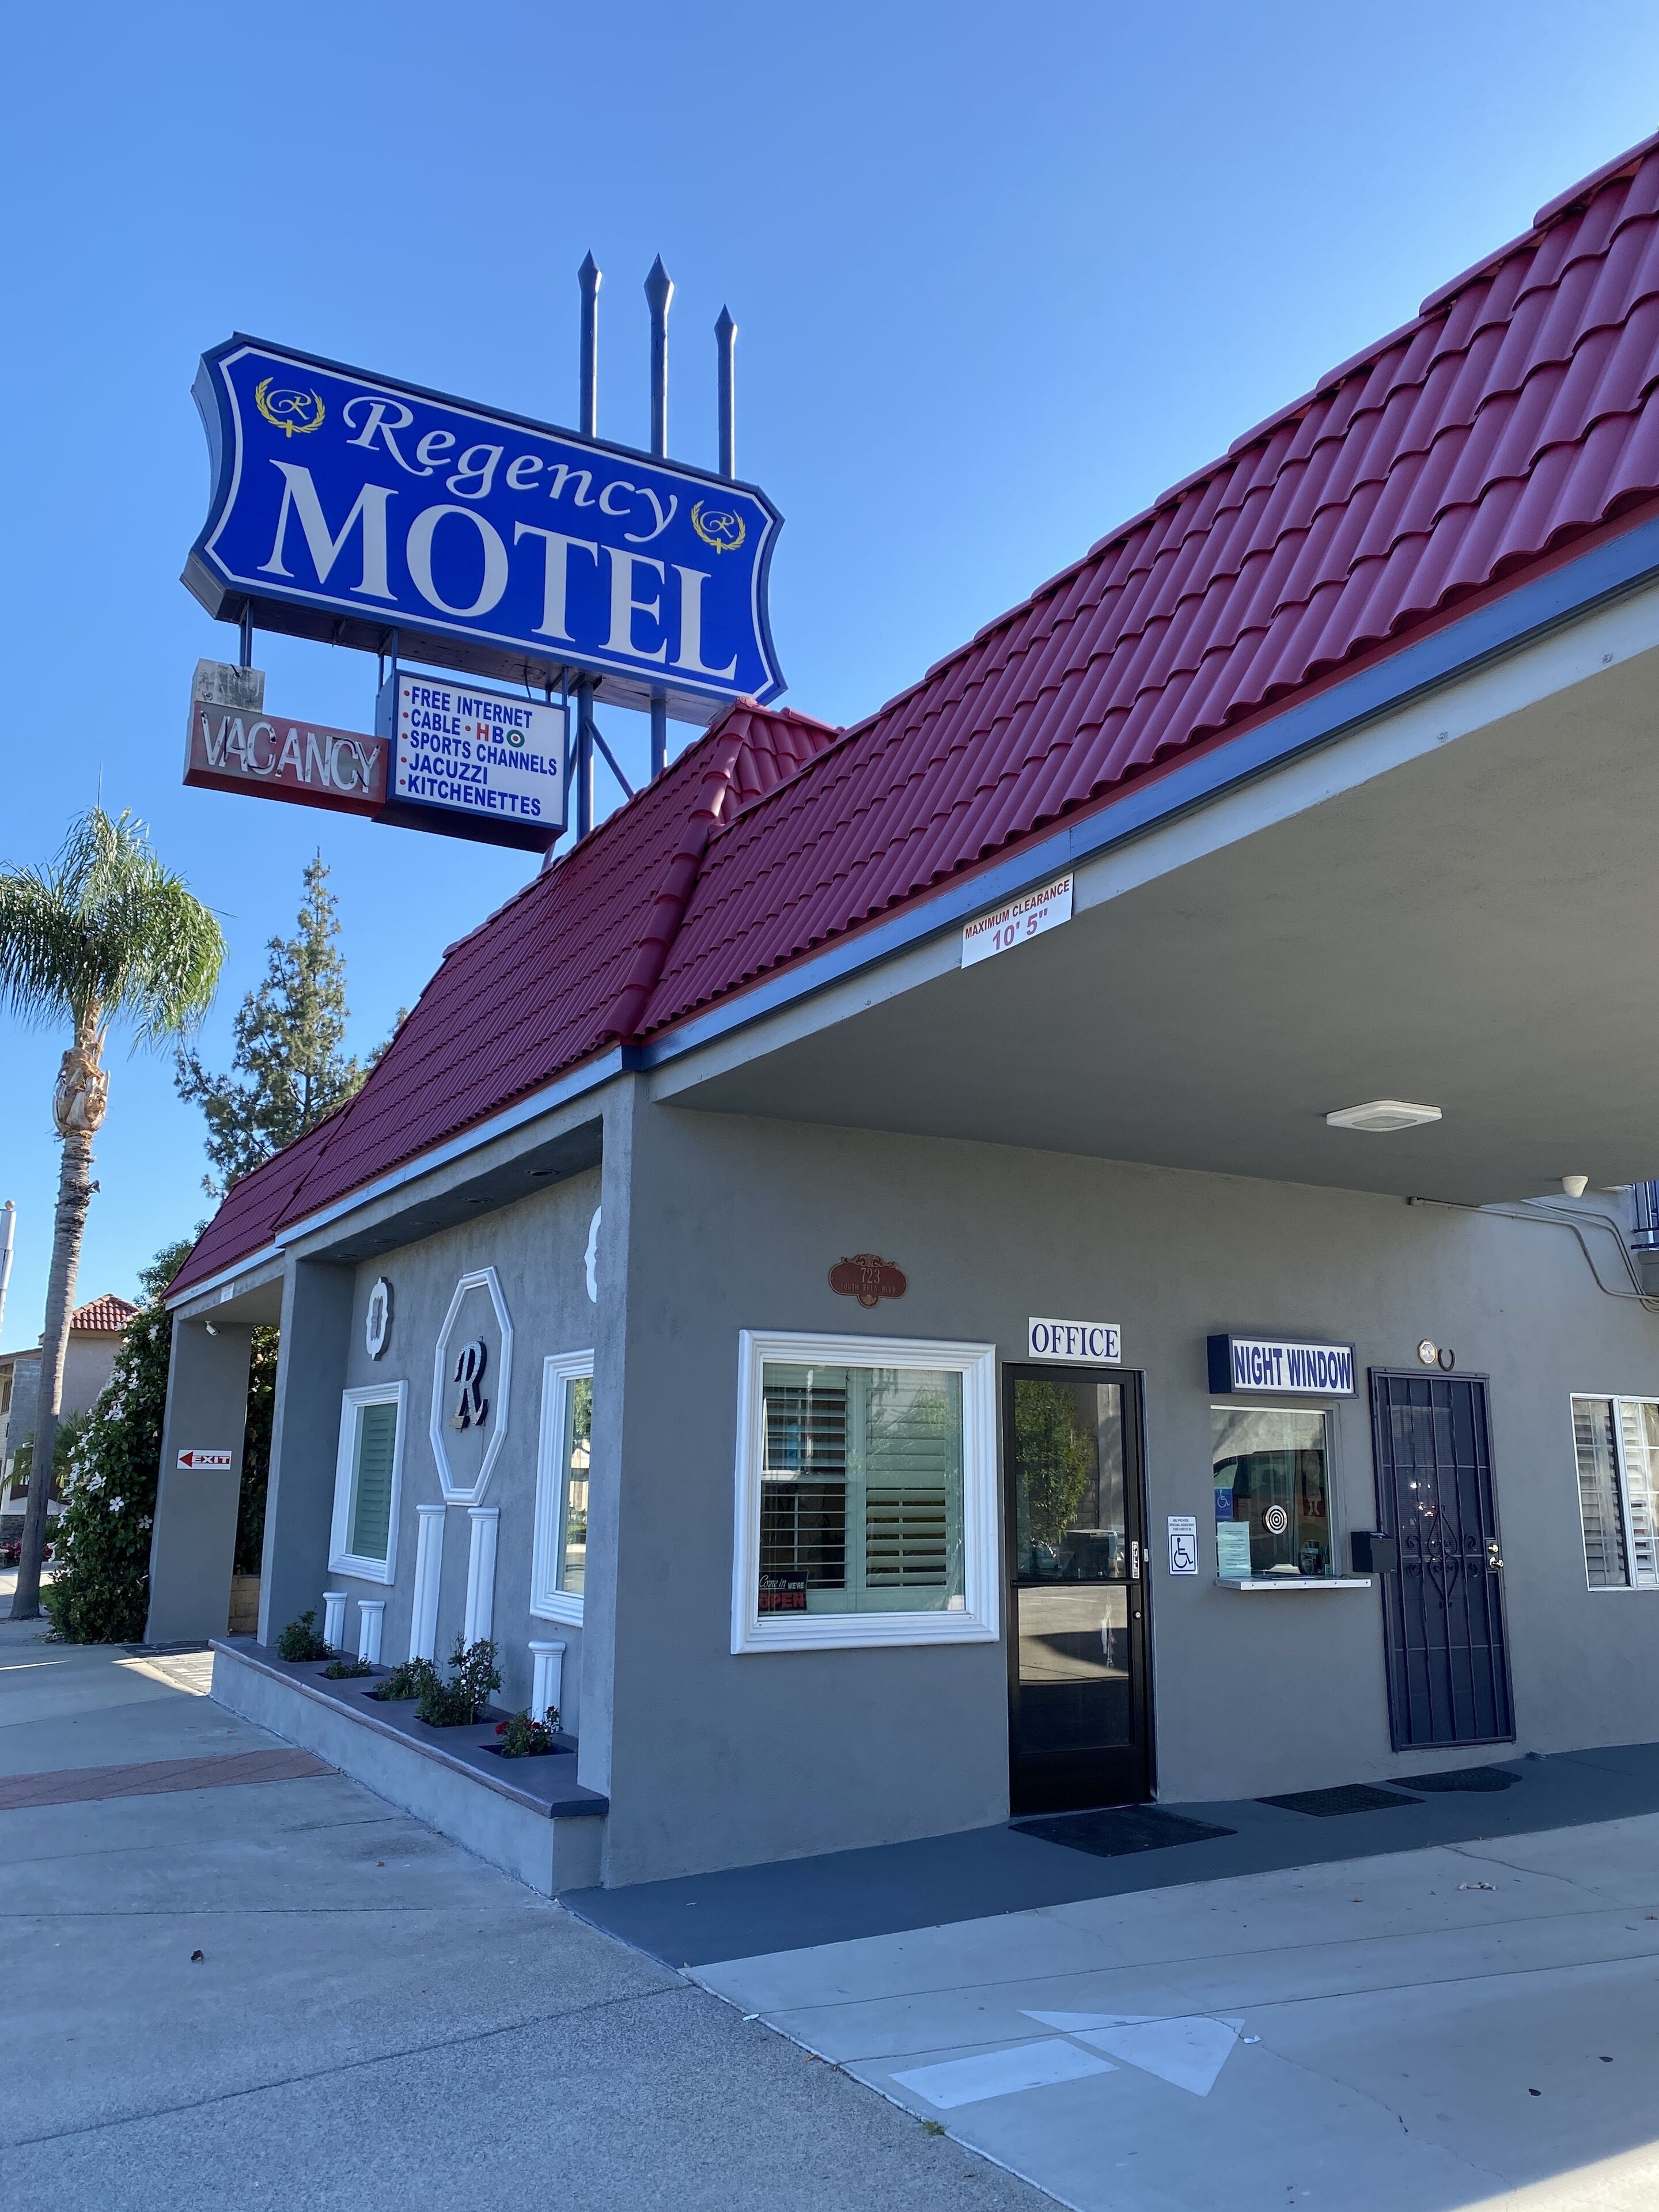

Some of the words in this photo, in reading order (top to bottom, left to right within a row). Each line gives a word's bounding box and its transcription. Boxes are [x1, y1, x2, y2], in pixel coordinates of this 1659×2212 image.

[342, 396, 679, 543] Regency
[256, 459, 738, 681] MOTEL
[410, 709, 461, 736] CABLE
[411, 685, 451, 712] FREE
[457, 695, 533, 729] INTERNET
[200, 710, 381, 794] VACANCY
[408, 752, 488, 785] JACUZZI
[410, 729, 471, 759] SPORTS
[476, 743, 558, 777] CHANNELS
[407, 774, 541, 816] KITCHENETTES
[965, 909, 1010, 940] MAXIMUM
[1012, 878, 1070, 918] CLEARANCE
[992, 921, 1020, 951] 10'
[840, 1282, 859, 1291] SOUTH
[863, 1283, 877, 1292] BREA
[881, 1285, 896, 1294] BLVD
[861, 1267, 880, 1284] 723
[1032, 1323, 1119, 1358] OFFICE
[1234, 1345, 1283, 1386] NIGHT
[1286, 1349, 1351, 1389] WINDOW
[192, 1456, 230, 1464] EXIT
[759, 1574, 778, 1588] Come
[779, 1578, 787, 1588] in
[759, 1593, 804, 1609] OPEN
